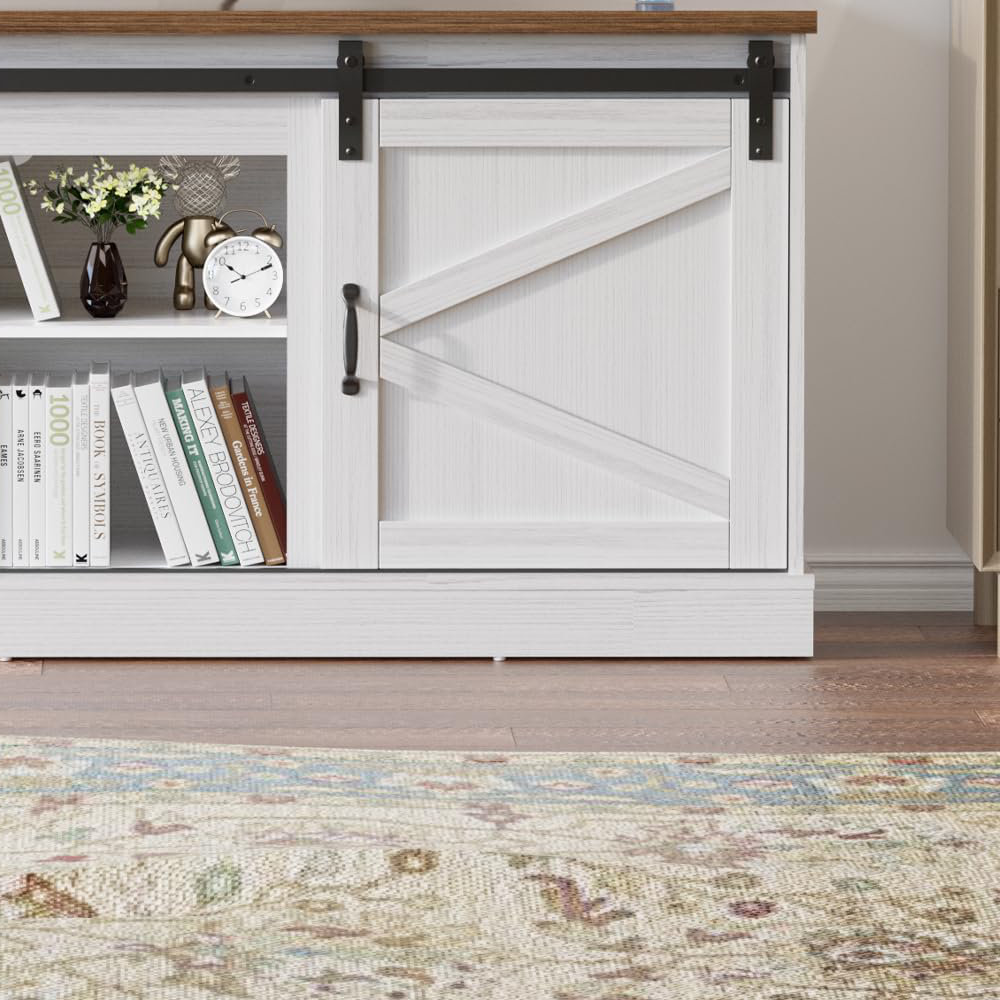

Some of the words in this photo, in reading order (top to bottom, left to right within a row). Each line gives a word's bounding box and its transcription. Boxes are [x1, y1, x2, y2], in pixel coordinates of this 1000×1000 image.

[266, 255, 273, 265] 2
[272, 270, 278, 280] 3
[212, 287, 219, 296] 8
[224, 296, 230, 305] 7
[255, 297, 261, 307] 5
[265, 287, 272, 296] 4
[239, 301, 247, 311] 6
[49, 394, 70, 447] 1000
[159, 417, 169, 433] NEW
[172, 398, 195, 443] MAKING
[187, 443, 200, 456] IT
[241, 401, 255, 424] TEXTILE
[248, 423, 265, 456] DESIGNERS
[17, 429, 25, 446] ARNE
[93, 420, 105, 457] BOOK
[163, 432, 177, 457] URBAN
[0, 444, 8, 467] EAMES
[17, 449, 25, 483] JACOBSEN
[232, 440, 249, 477] Gardens
[170, 456, 186, 487] HOUSING
[187, 388, 222, 447] ALEXEY
[208, 449, 257, 553] BRODOVITCH
[243, 476, 254, 487] in
[93, 472, 106, 540] SYMBOLS
[247, 487, 262, 518] France
